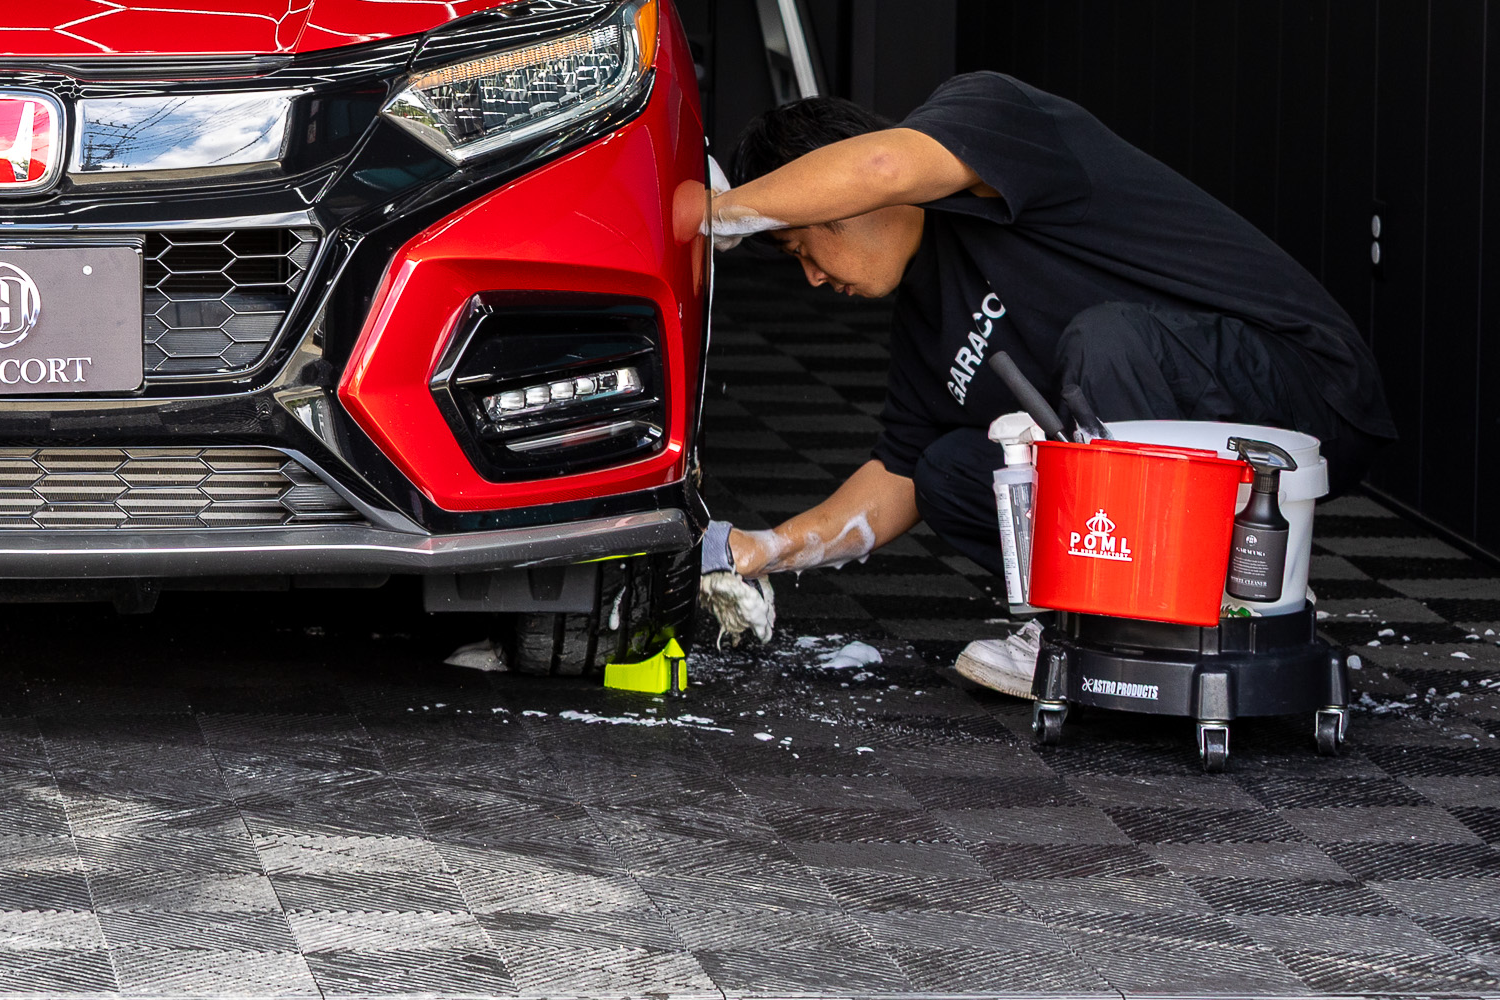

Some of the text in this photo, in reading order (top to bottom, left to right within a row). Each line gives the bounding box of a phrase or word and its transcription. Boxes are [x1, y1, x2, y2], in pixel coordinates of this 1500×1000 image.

[947, 292, 1006, 405] GARACO
[1070, 531, 1131, 554] POML
[1093, 679, 1159, 699] ASTRO PRODUCTS
